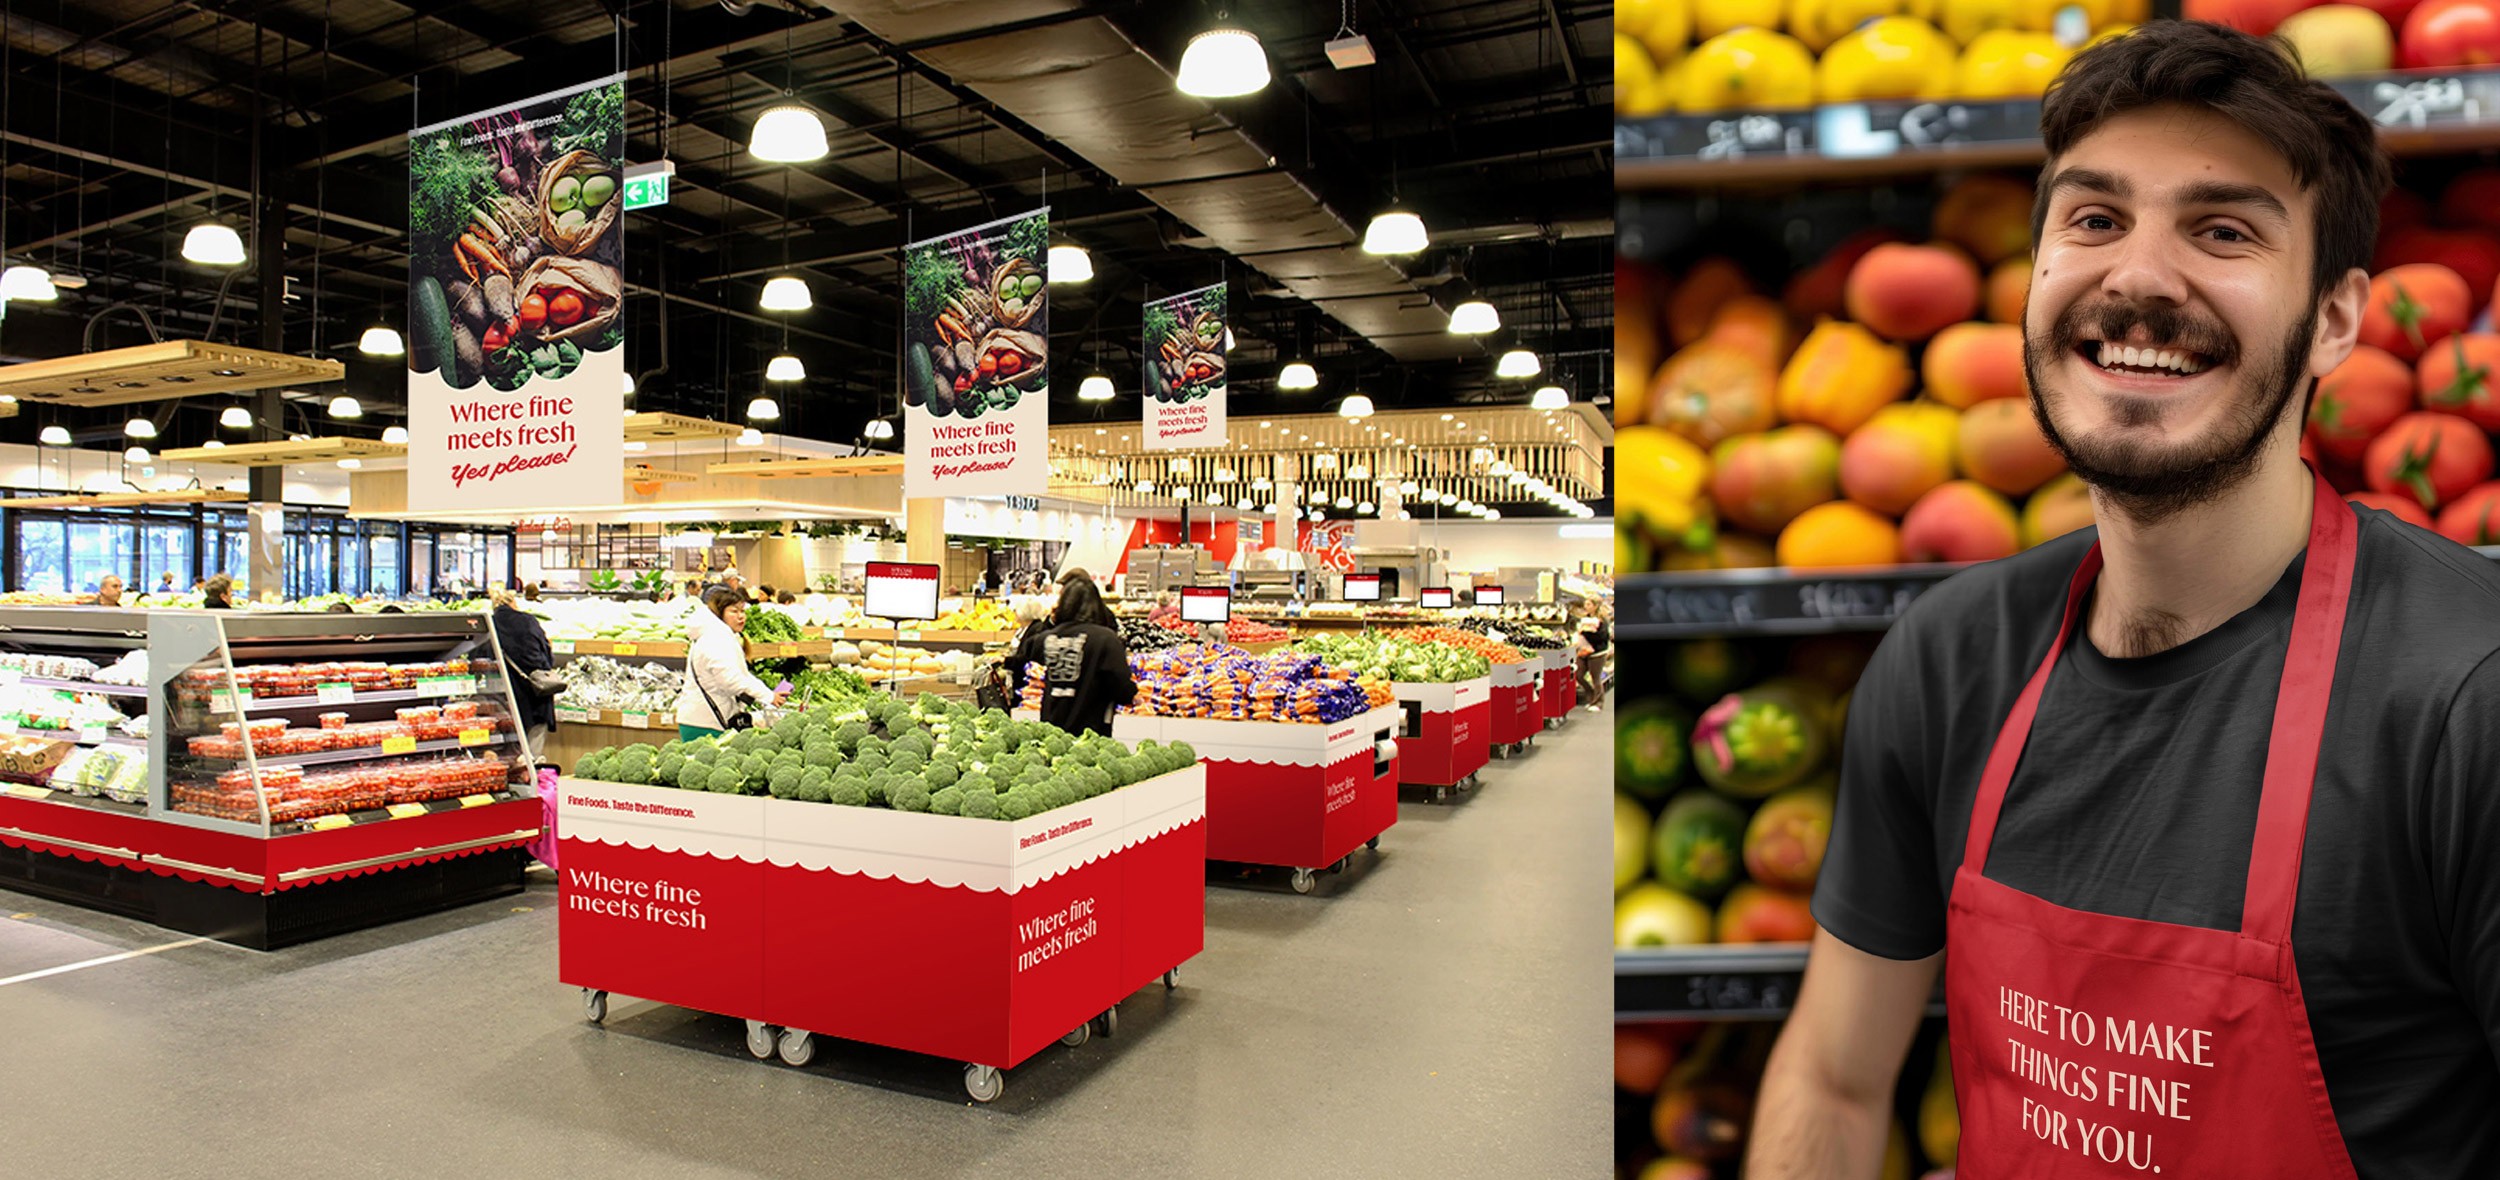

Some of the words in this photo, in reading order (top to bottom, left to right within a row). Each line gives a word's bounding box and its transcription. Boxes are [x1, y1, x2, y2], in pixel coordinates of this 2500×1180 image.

[449, 402, 524, 424] Where
[529, 395, 573, 418] fine
[447, 427, 512, 451] meets
[518, 420, 575, 446] fresh
[931, 442, 975, 458] meets
[978, 438, 1017, 455] fresh
[932, 425, 982, 440] Where
[985, 421, 1015, 436] fine
[451, 463, 490, 489] Yes
[488, 443, 577, 482] please!
[932, 464, 958, 481] Yes
[956, 457, 1015, 477] please!
[567, 795, 584, 806] Fine
[584, 797, 611, 810] Foods.
[612, 799, 634, 812] Taste
[634, 802, 649, 814] the
[649, 803, 696, 819] Difference.
[569, 868, 650, 898] Where
[654, 880, 702, 906] fine
[569, 894, 641, 920] meets
[645, 901, 707, 930] fresh
[1019, 909, 1068, 944] Where
[1070, 897, 1096, 924] fine
[1018, 935, 1064, 973] meets
[1064, 917, 1098, 951] fresh
[2000, 985, 2050, 1036] HERE
[2053, 1004, 2097, 1047] TO
[2105, 1016, 2215, 1068] MAKE
[2007, 1037, 2098, 1103] THINGS
[2107, 1070, 2192, 1121] FINE
[2022, 1096, 2070, 1150] FOR
[2076, 1117, 2162, 1174] YOU.
